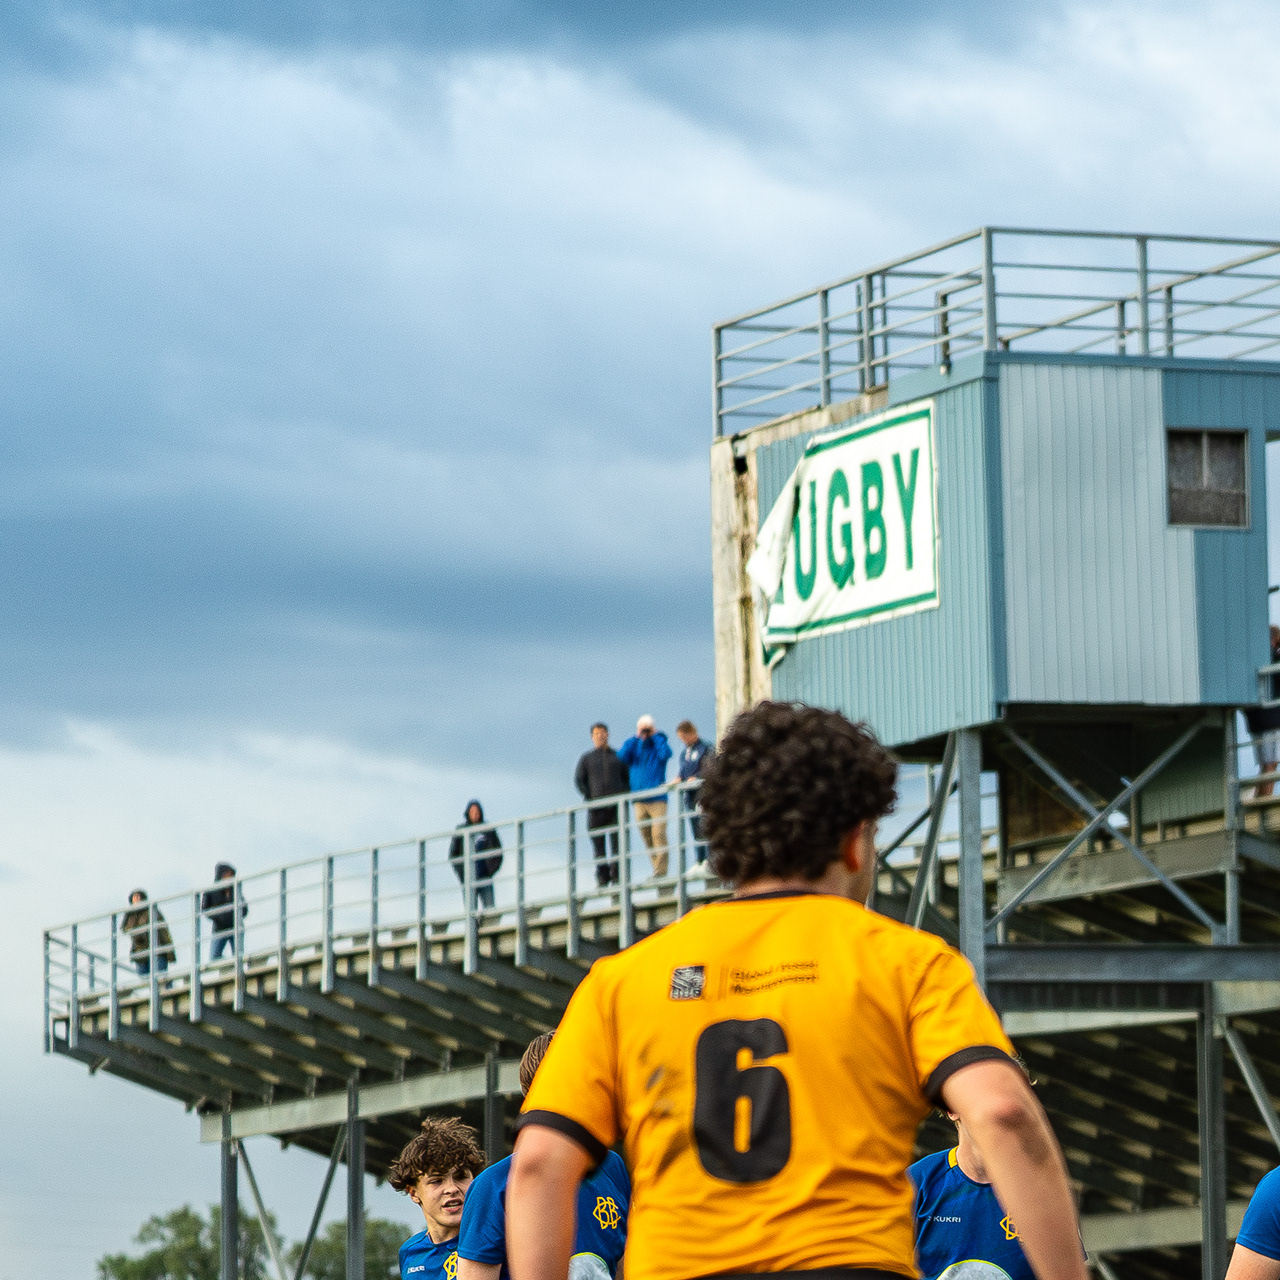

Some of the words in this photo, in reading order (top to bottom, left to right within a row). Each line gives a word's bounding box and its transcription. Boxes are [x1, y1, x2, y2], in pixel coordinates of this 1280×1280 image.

[773, 447, 920, 604] UGBY
[694, 1018, 792, 1183] 6
[933, 1215, 961, 1223] KUKRI
